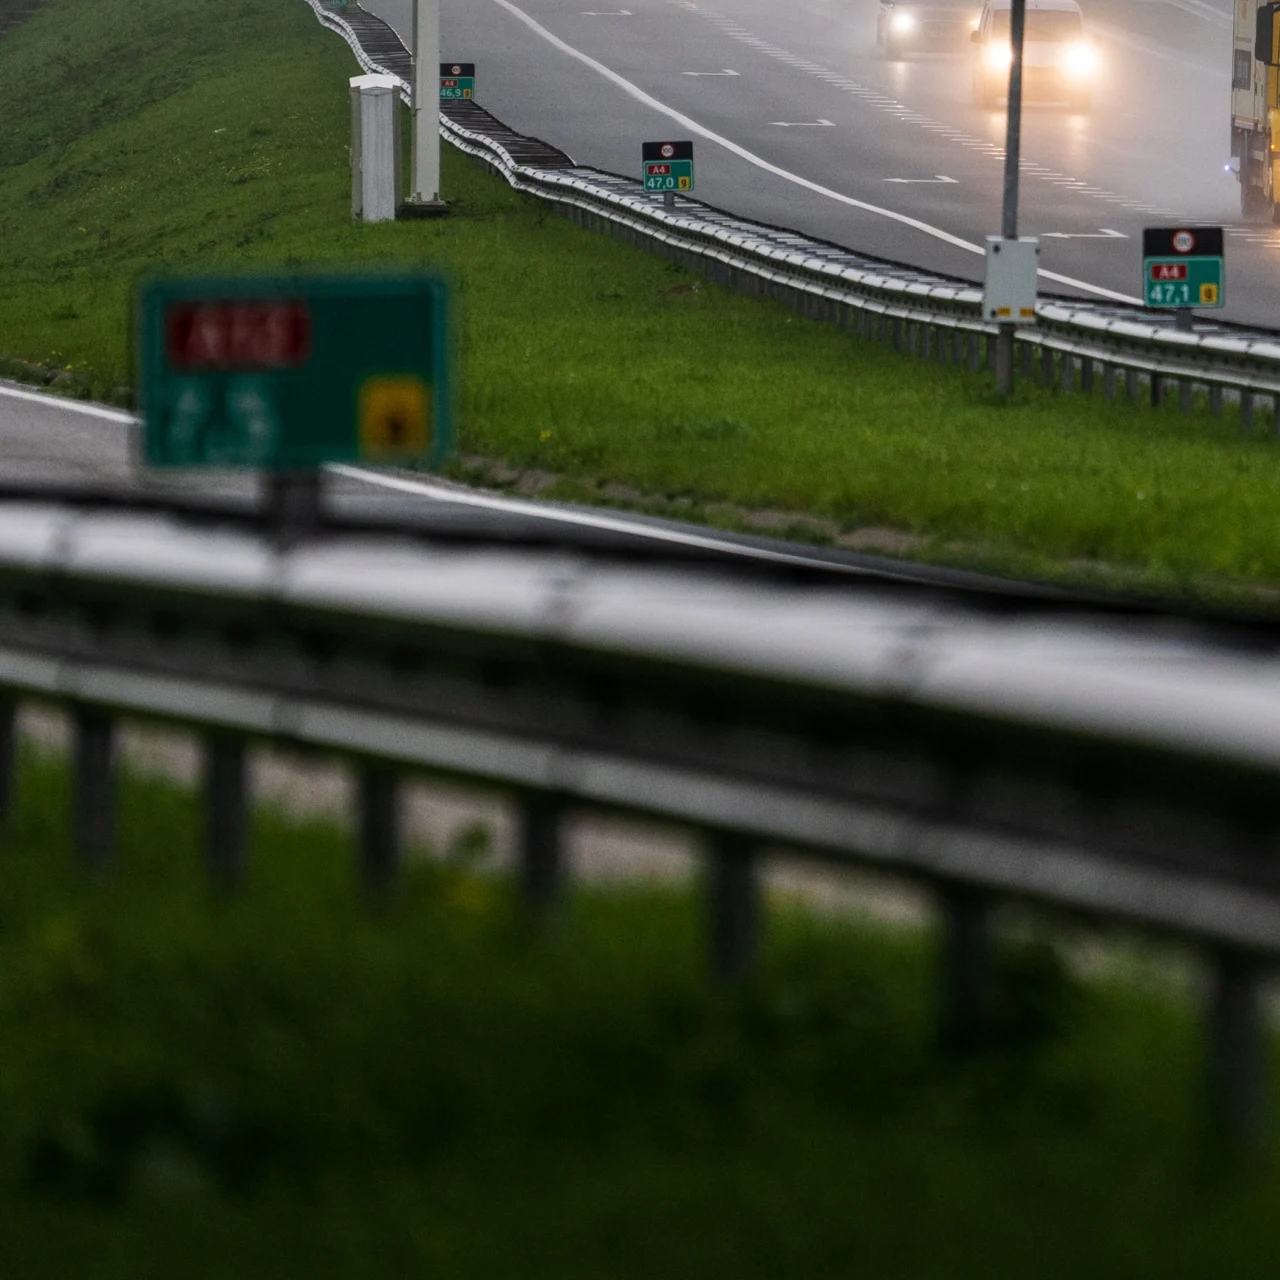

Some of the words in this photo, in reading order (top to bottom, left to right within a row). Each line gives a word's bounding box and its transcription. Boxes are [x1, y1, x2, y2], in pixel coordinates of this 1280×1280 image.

[652, 166, 666, 174] A4
[647, 177, 674, 189] 47,0
[1159, 265, 1180, 278] A4
[1150, 283, 1189, 304] 47,1
